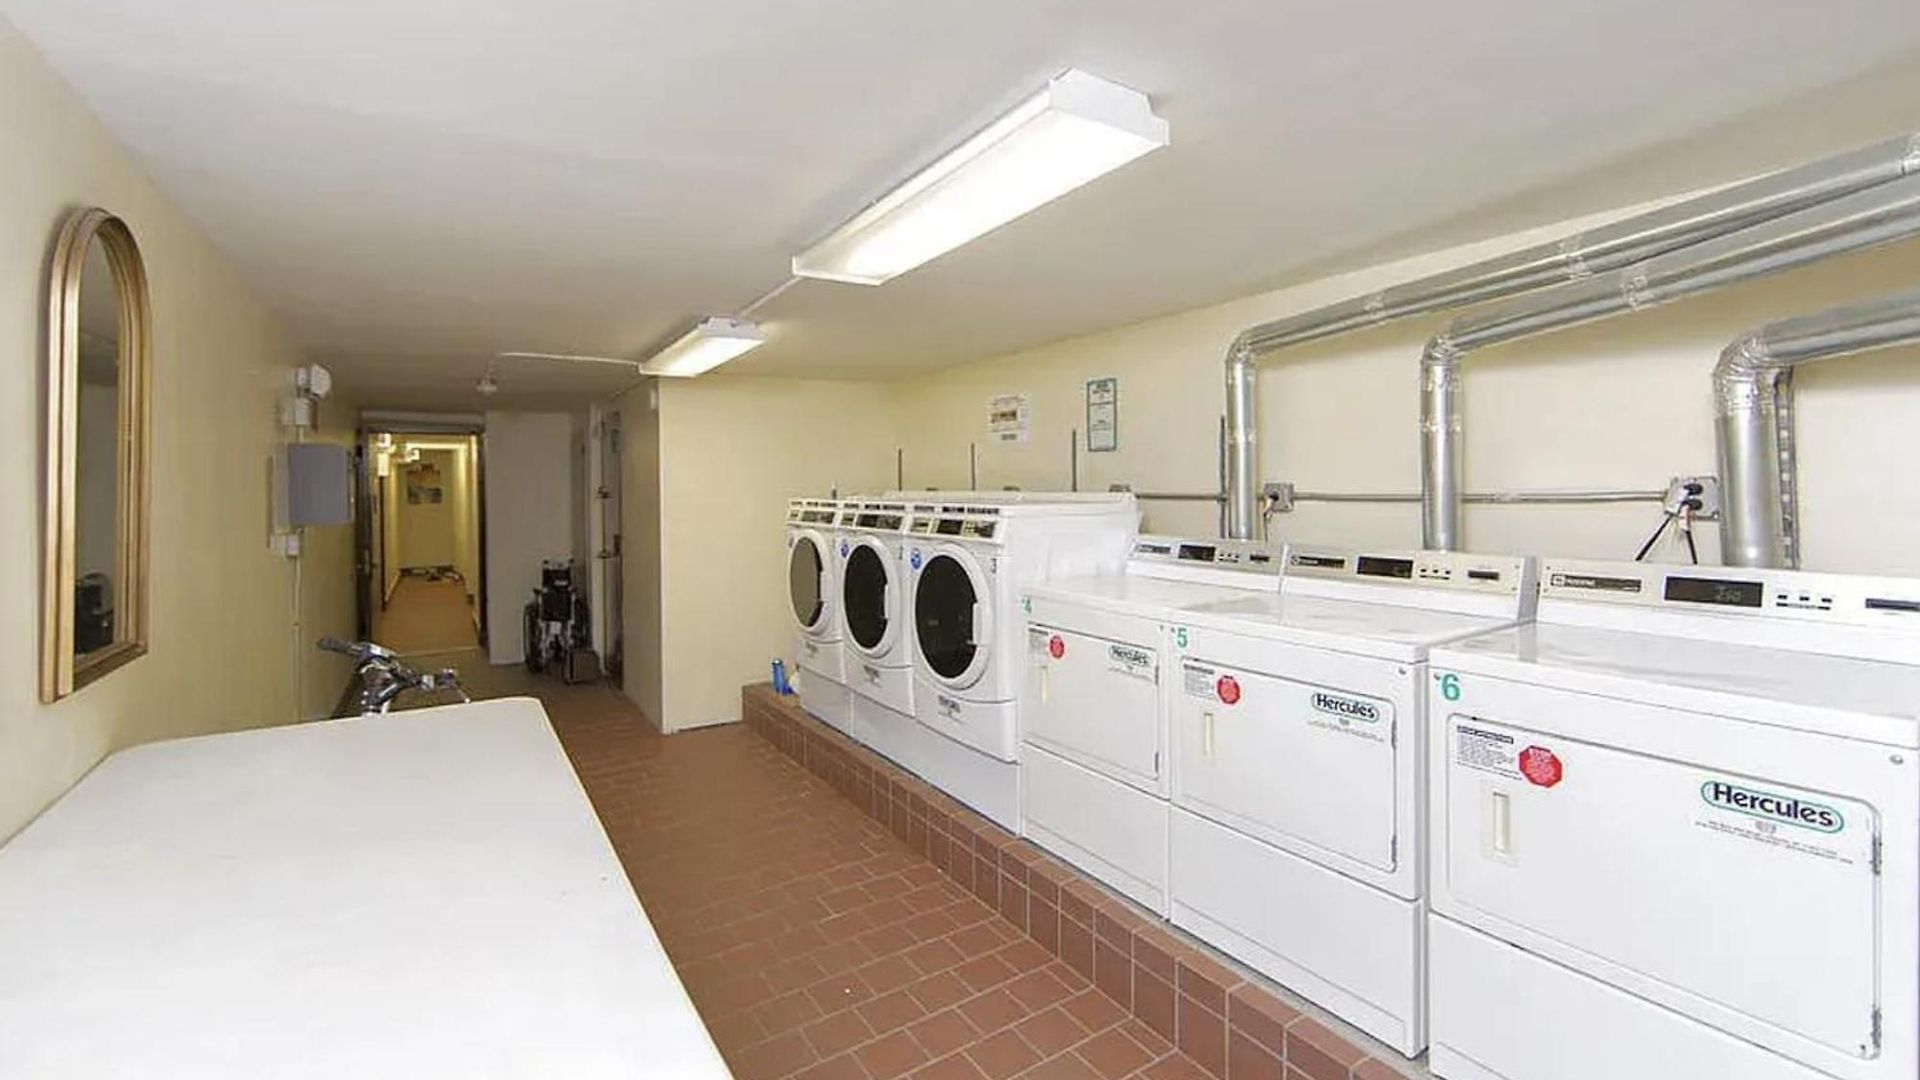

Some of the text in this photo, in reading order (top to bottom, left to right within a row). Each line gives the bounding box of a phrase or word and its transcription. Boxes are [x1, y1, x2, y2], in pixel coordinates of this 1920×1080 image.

[1024, 598, 1033, 614] 4
[1177, 627, 1188, 648] 5
[1441, 673, 1461, 702] 6
[1316, 693, 1375, 719] Hercules
[1713, 781, 1835, 827] Hercules
